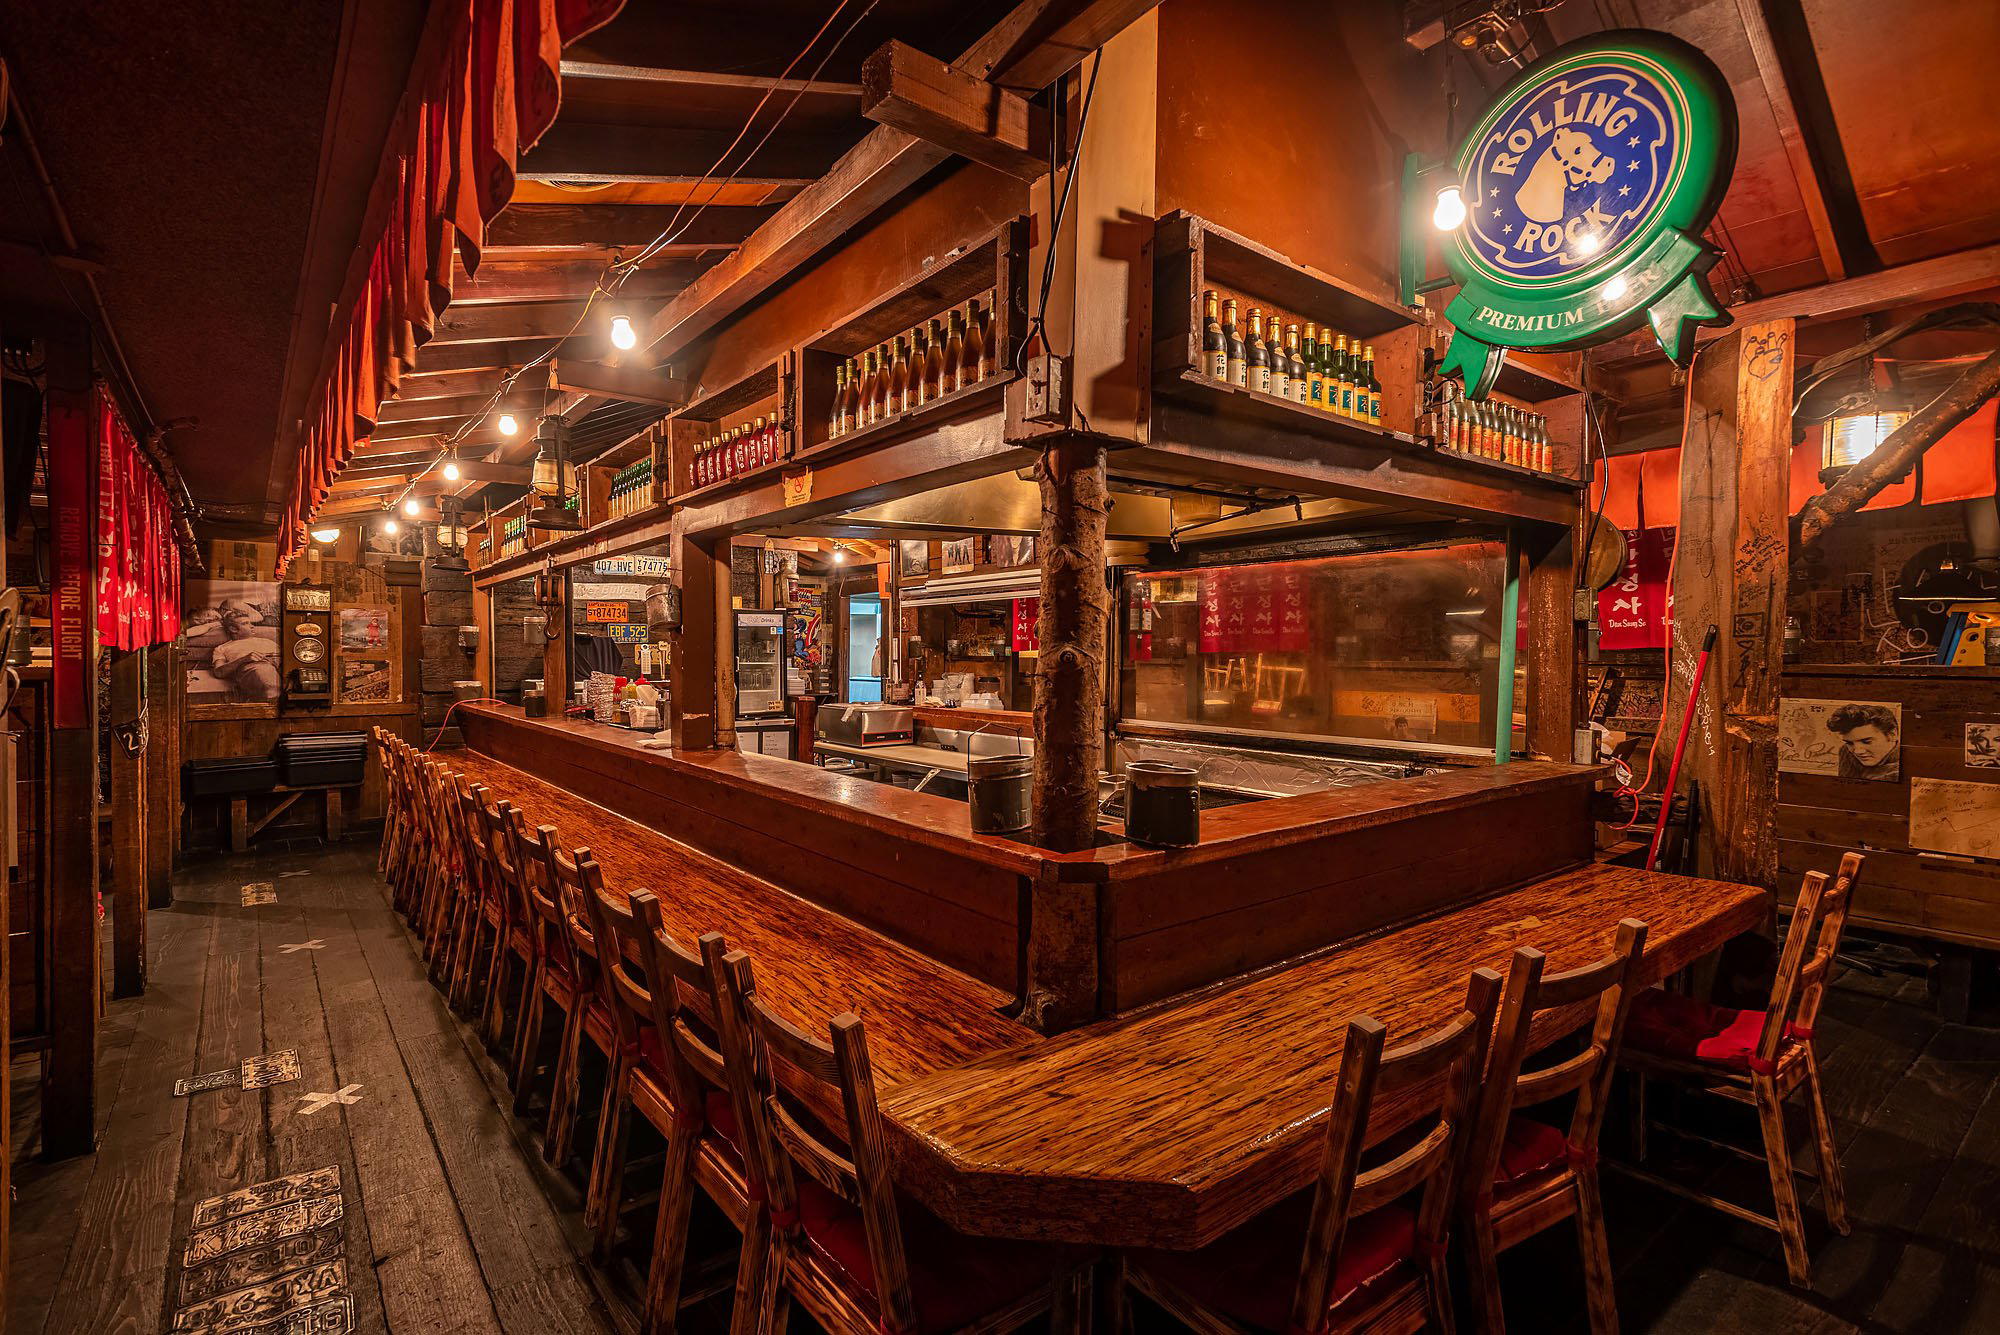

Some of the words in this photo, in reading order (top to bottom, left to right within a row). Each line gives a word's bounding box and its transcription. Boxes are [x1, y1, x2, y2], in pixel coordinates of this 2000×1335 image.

[1491, 92, 1638, 176] ROLLING
[1513, 197, 1617, 253] ROCK
[1476, 306, 1584, 331] PREMIUM
[60, 507, 80, 561] REMOVE
[60, 565, 80, 611] BEFORE
[596, 560, 612, 572] 407
[61, 617, 82, 660] FLIGHT
[609, 624, 626, 637] EBF
[630, 624, 647, 637] 525
